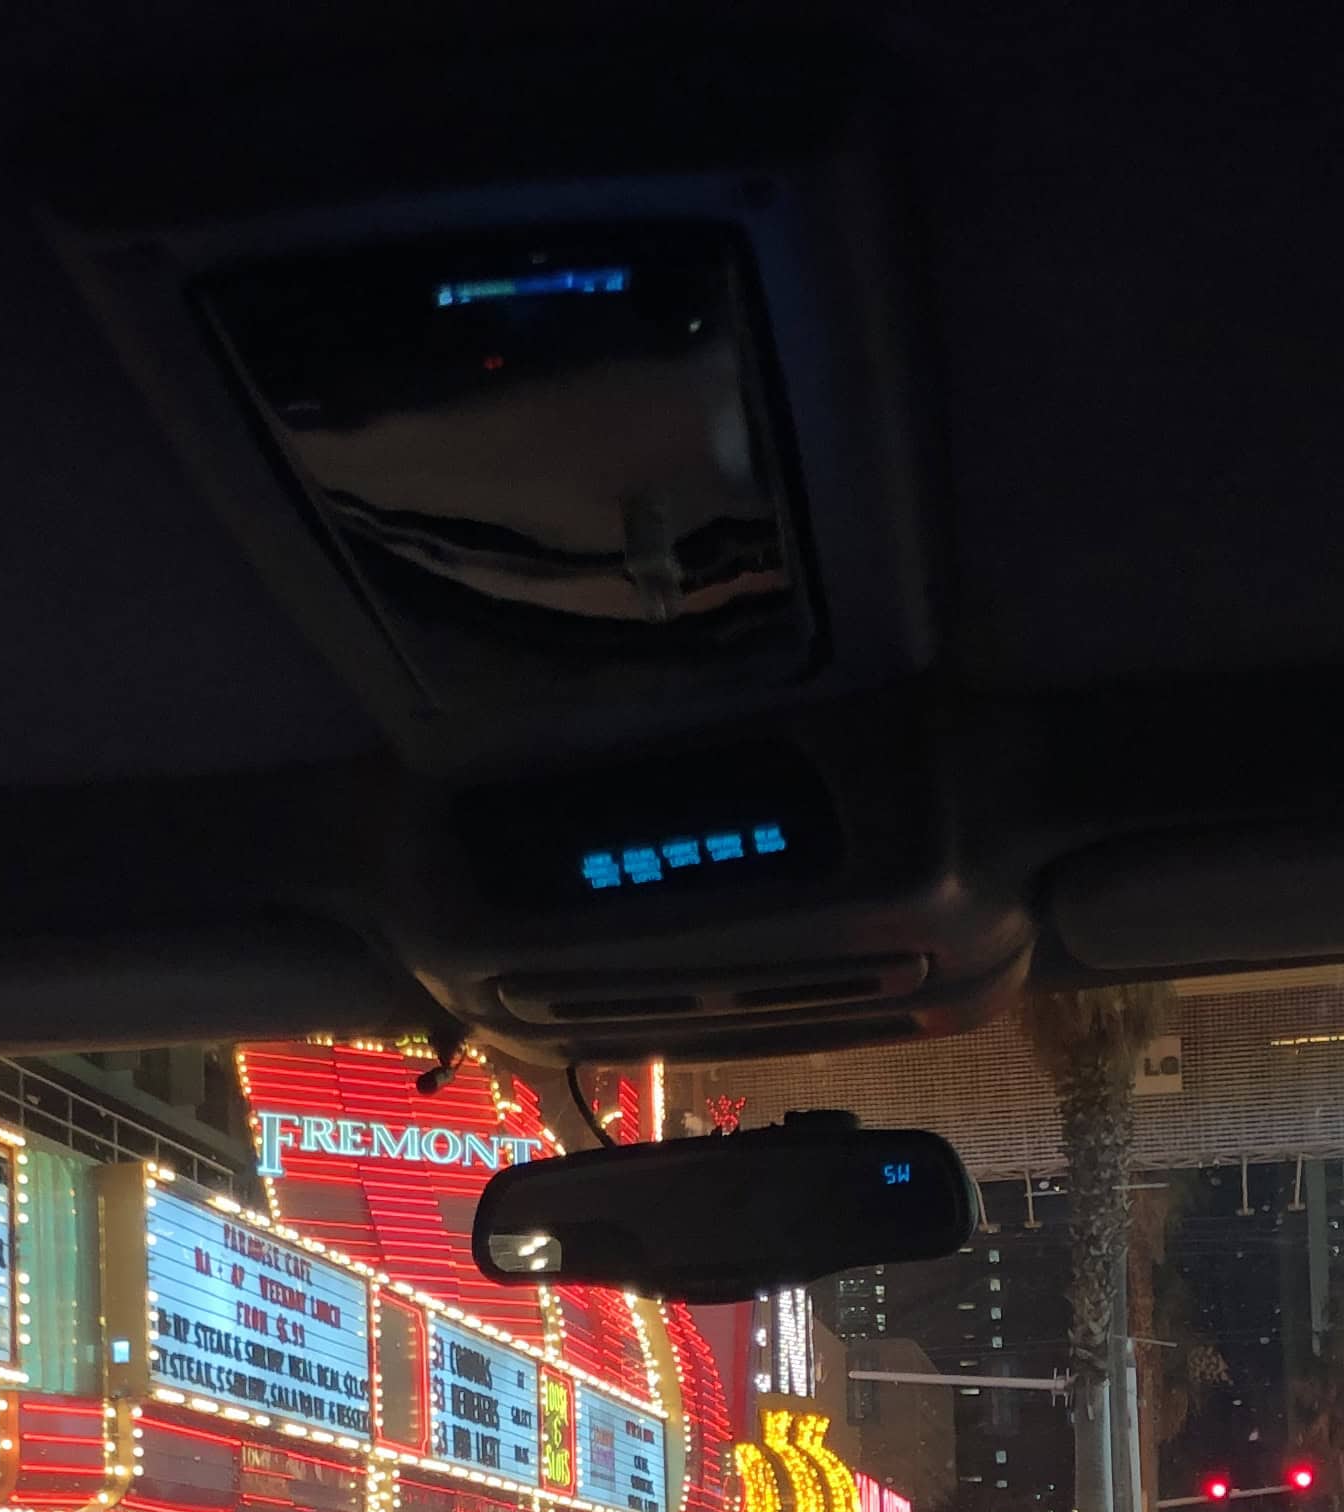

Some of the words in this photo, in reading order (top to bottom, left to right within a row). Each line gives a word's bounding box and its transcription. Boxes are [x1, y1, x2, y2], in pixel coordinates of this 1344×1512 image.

[257, 1111, 542, 1176] FREMONT
[884, 1164, 910, 1184] SW
[194, 1321, 233, 1359] STEAK
